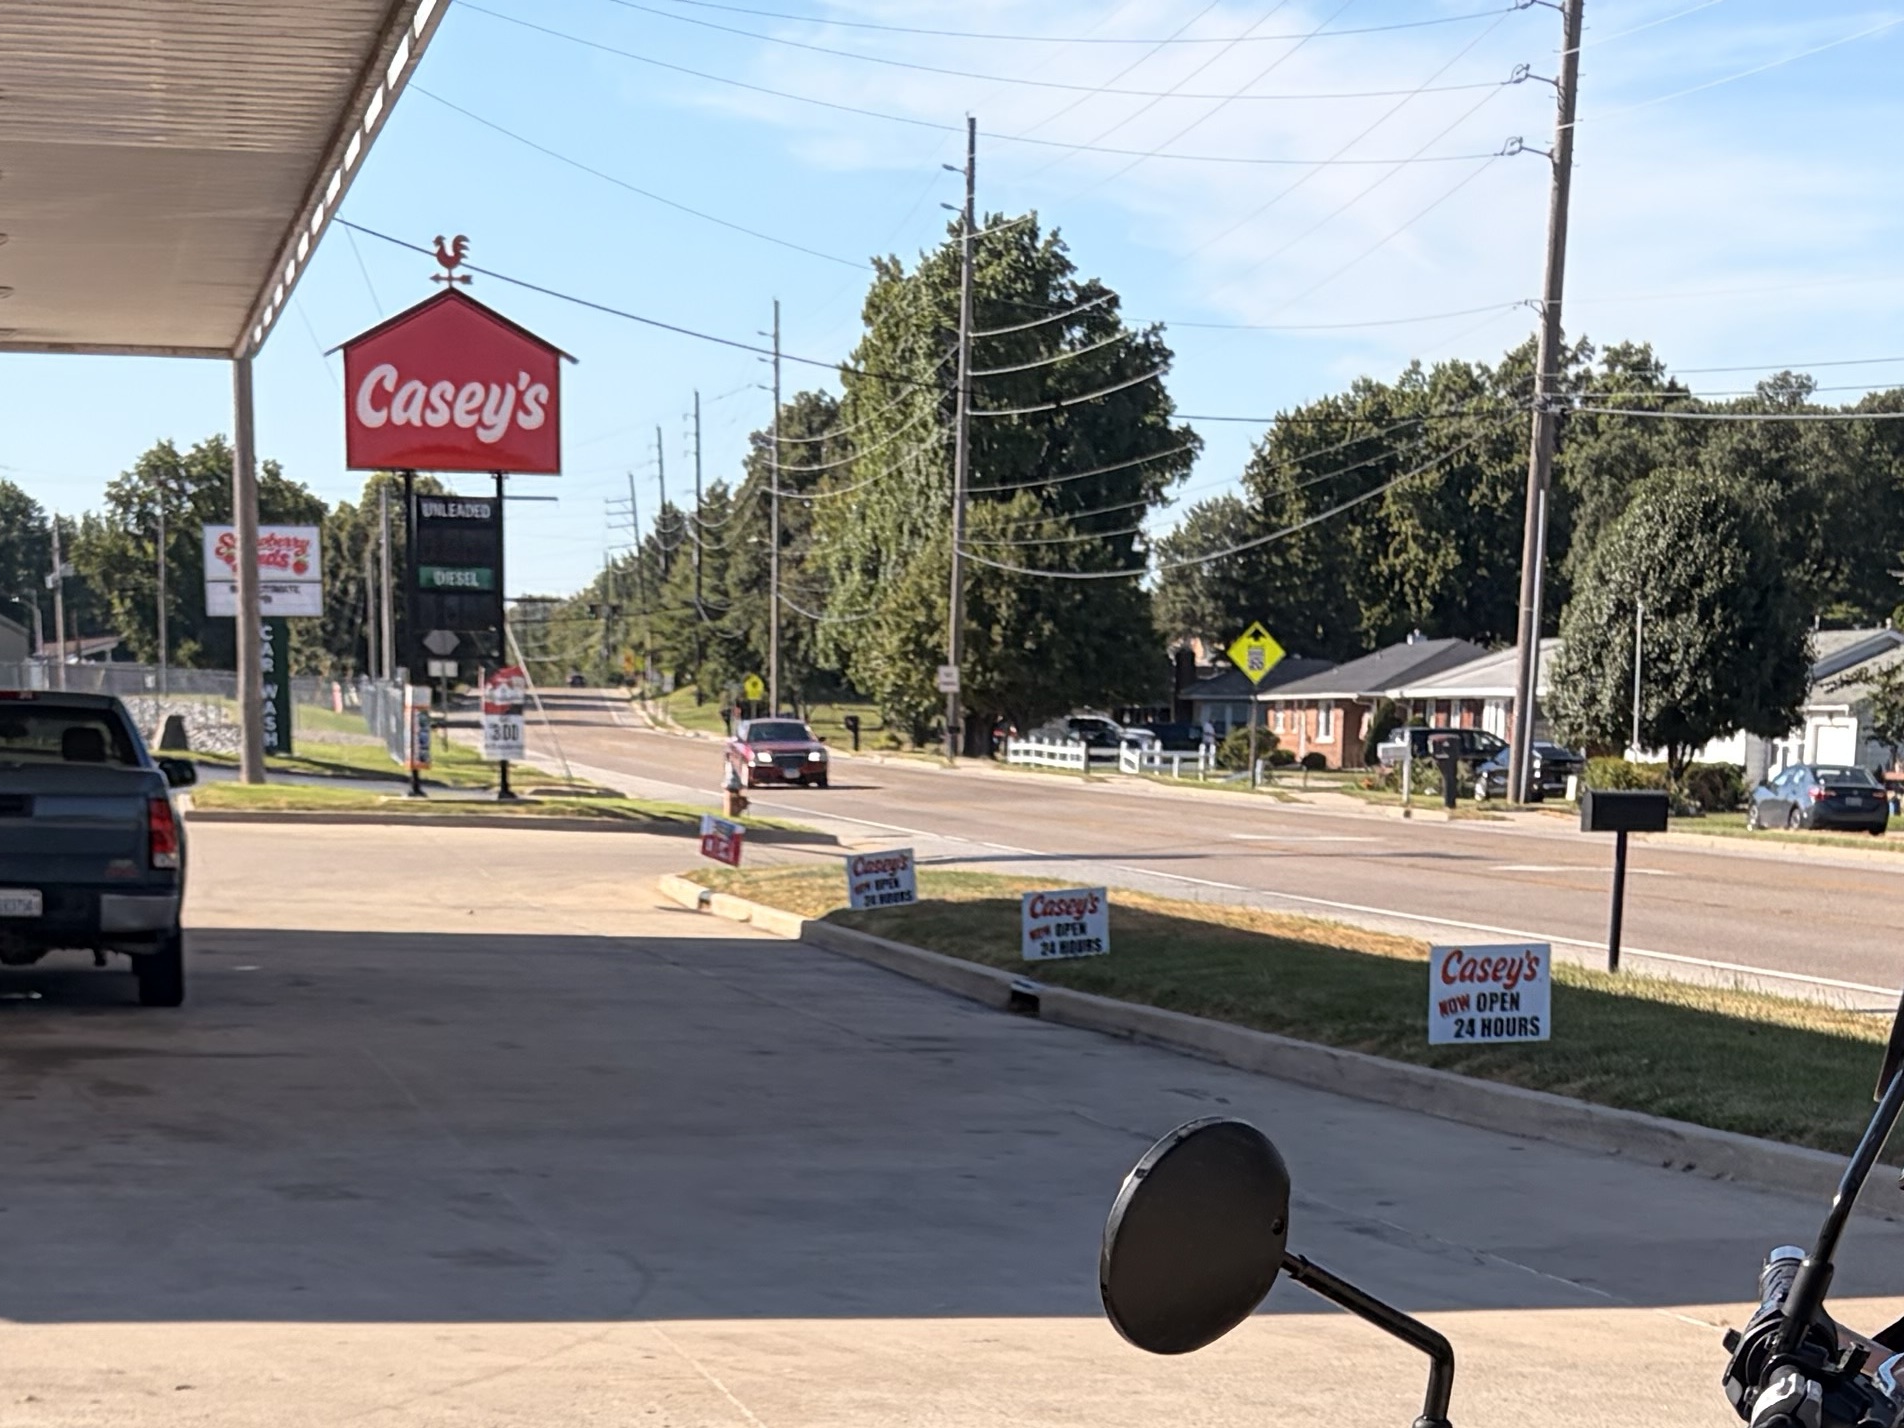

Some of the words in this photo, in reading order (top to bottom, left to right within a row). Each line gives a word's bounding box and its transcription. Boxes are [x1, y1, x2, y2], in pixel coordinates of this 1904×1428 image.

[356, 363, 550, 444] Casey's
[420, 501, 492, 519] UNLEADED
[432, 569, 480, 588] DIESEL
[262, 684, 279, 748] WASH
[852, 853, 910, 878] Casey's
[874, 877, 901, 891] OPEN
[879, 889, 914, 906] HOURS
[1028, 891, 1101, 921] Casey's
[1054, 921, 1088, 938] OPEN
[1040, 941, 1057, 956] 24
[1059, 937, 1103, 955] HOURS
[1440, 948, 1541, 991] Casey's
[1438, 992, 1471, 1019] NOW
[1475, 991, 1521, 1013] OPEN
[1453, 1017, 1476, 1039] 24
[1480, 1016, 1541, 1038] HOURS
